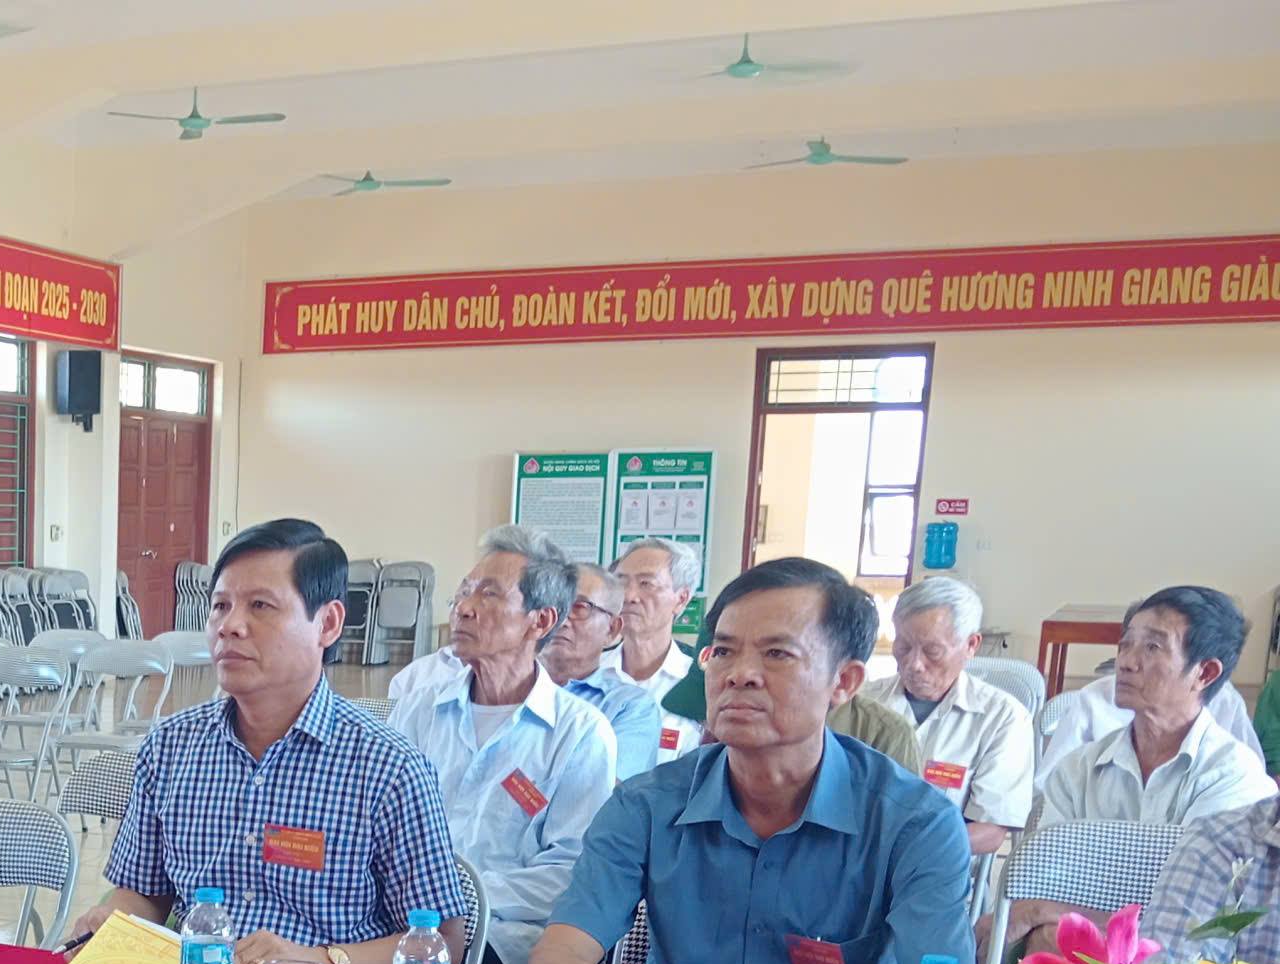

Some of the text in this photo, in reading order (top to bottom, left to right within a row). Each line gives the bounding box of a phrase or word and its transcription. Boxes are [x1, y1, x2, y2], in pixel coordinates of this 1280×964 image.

[4, 272, 38, 320] ĐOẠN
[41, 280, 69, 319] 2025
[80, 289, 106, 326] 2030
[298, 297, 350, 335] PHÁT
[356, 301, 397, 333] HUY
[404, 292, 448, 331] DÂN
[455, 285, 504, 331] CHỦ,
[513, 286, 575, 327] ĐOÀN
[582, 280, 627, 326] KẾT,
[636, 274, 676, 322] ĐỔI
[683, 279, 736, 323] MỚI,
[745, 277, 795, 318] XÂY
[802, 278, 873, 323] DỰNG
[882, 270, 933, 317] QUÊ
[941, 271, 1034, 312] HƯƠNG
[1043, 270, 1113, 307] NINH
[1122, 266, 1211, 305] GIANG
